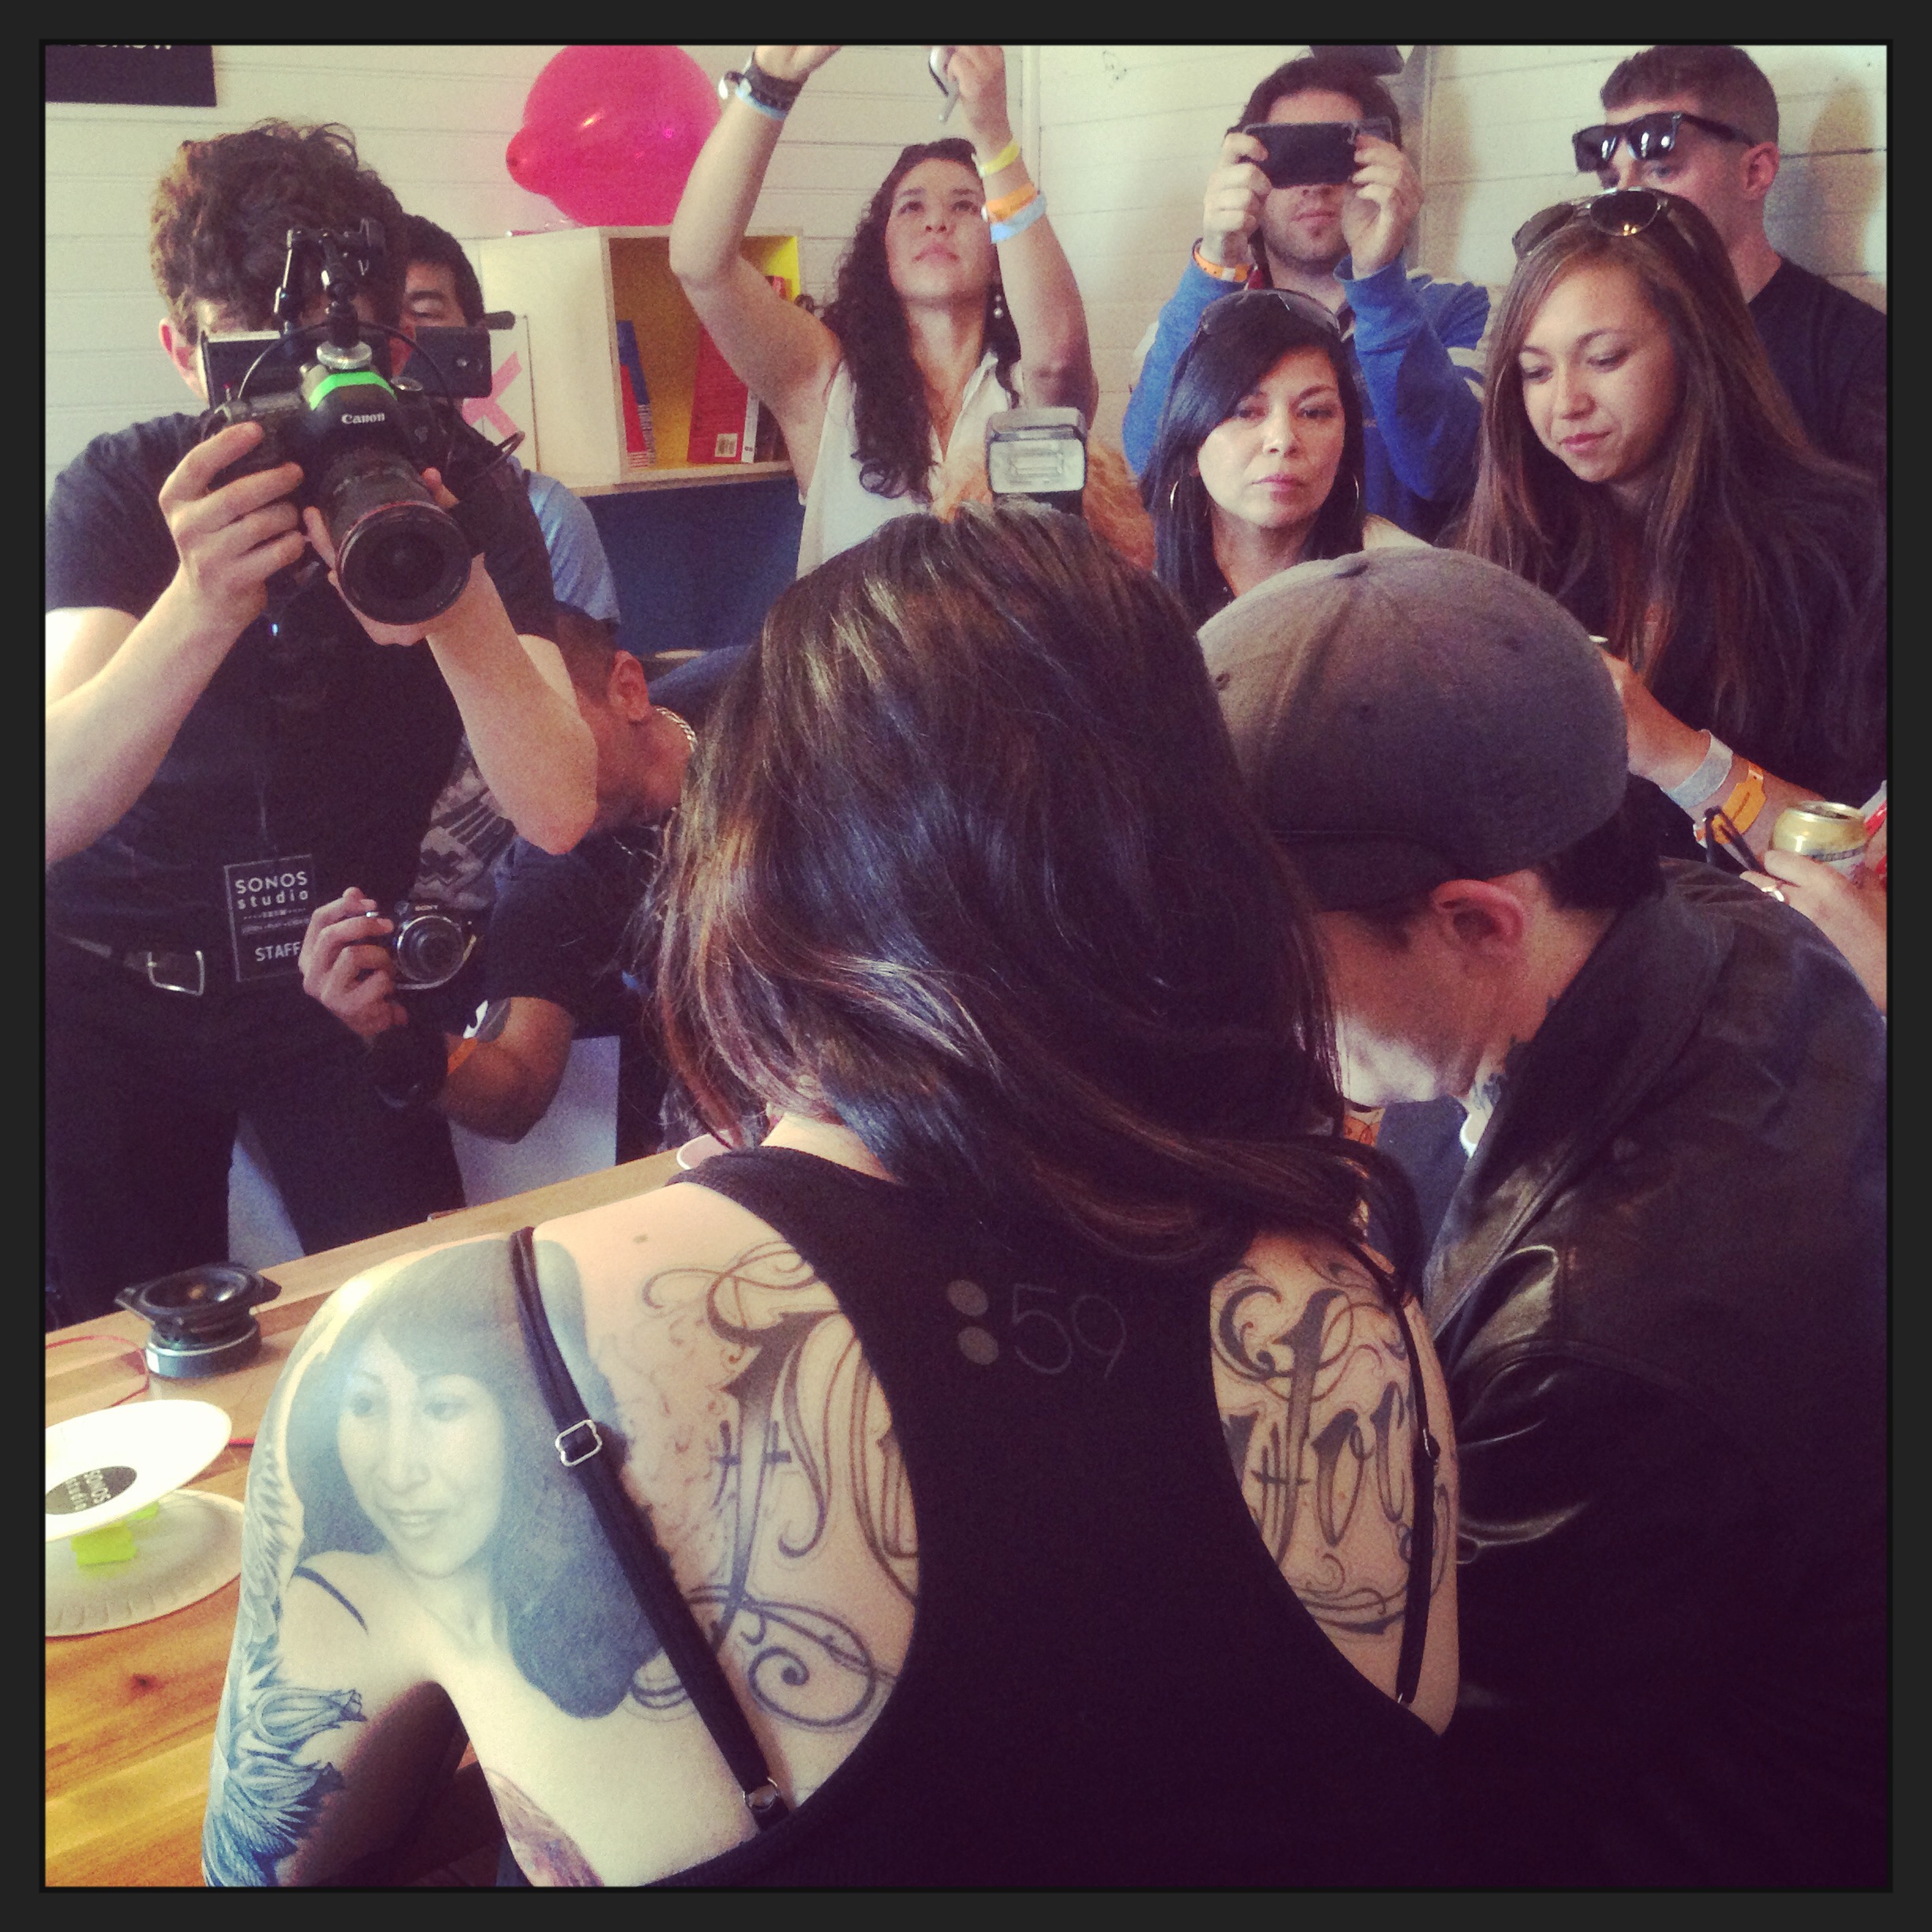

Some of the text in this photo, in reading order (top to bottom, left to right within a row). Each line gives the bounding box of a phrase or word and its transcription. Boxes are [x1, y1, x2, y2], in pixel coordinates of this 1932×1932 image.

[341, 413, 385, 425] Canon
[235, 871, 308, 894] SONOS
[238, 889, 308, 909] studio
[255, 942, 301, 962] STAFF
